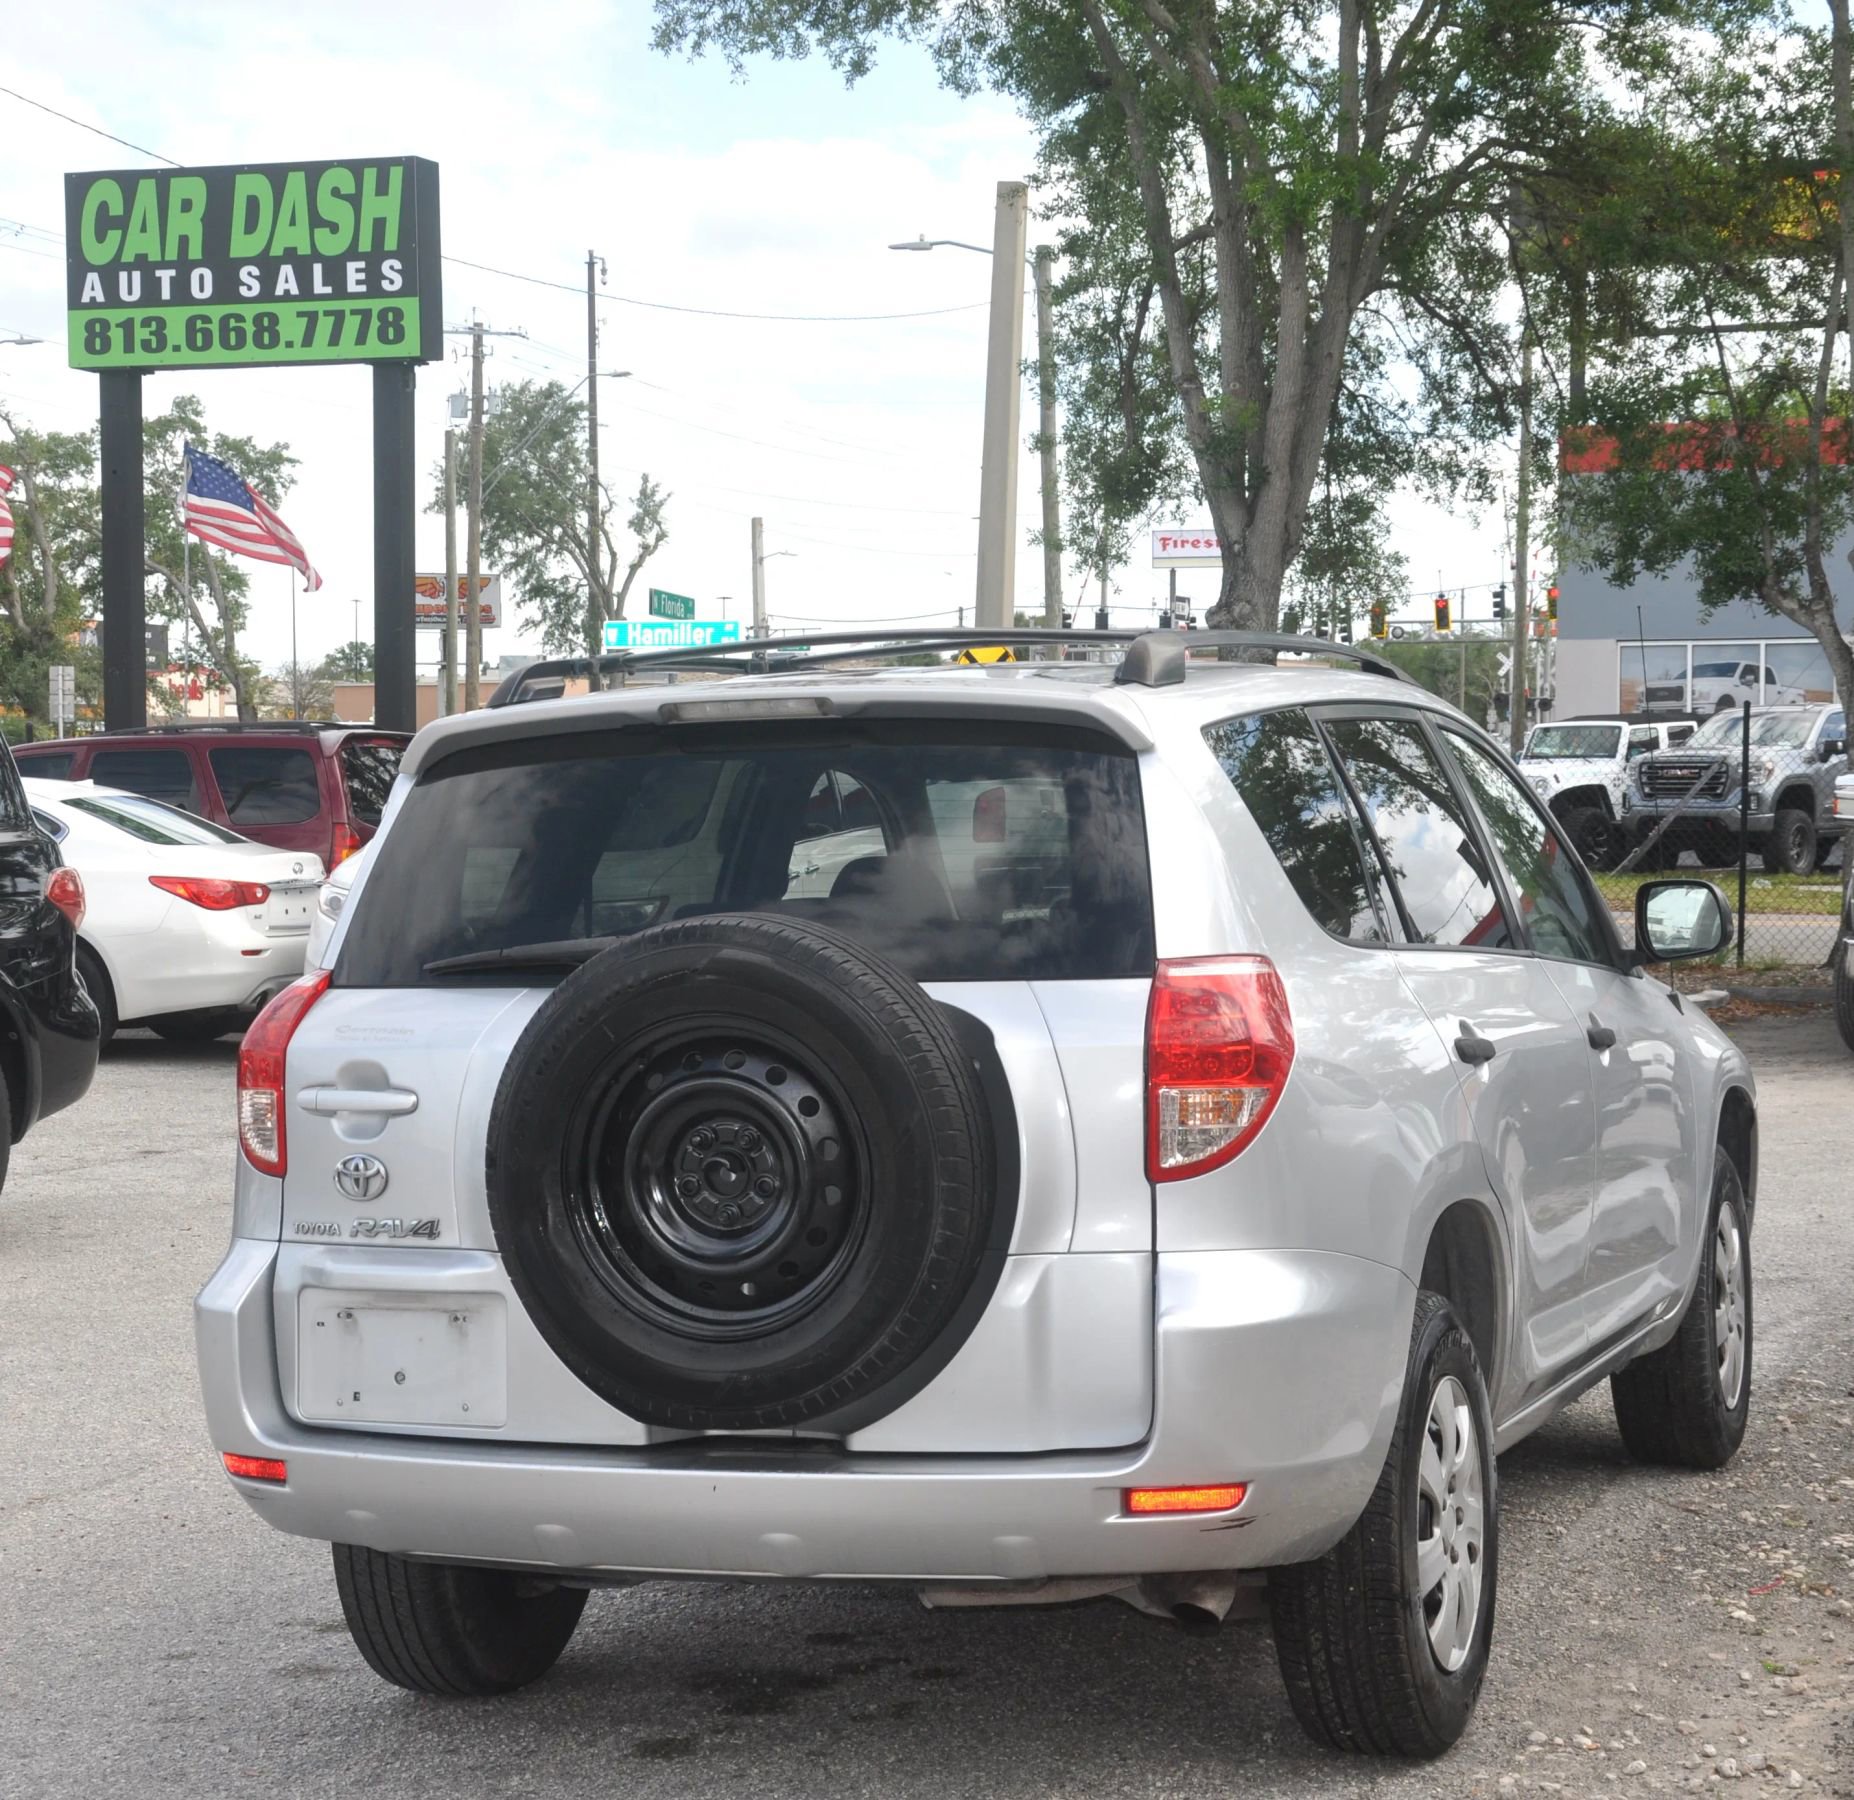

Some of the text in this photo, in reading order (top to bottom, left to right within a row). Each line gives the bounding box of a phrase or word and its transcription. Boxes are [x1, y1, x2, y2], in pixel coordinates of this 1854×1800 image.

[81, 165, 404, 266] CAR DASH
[81, 258, 403, 303] AUTO SALES
[84, 306, 406, 356] 813.668.7778
[661, 593, 685, 618] Florida
[293, 1217, 441, 1241] TOYOTA RAV4
